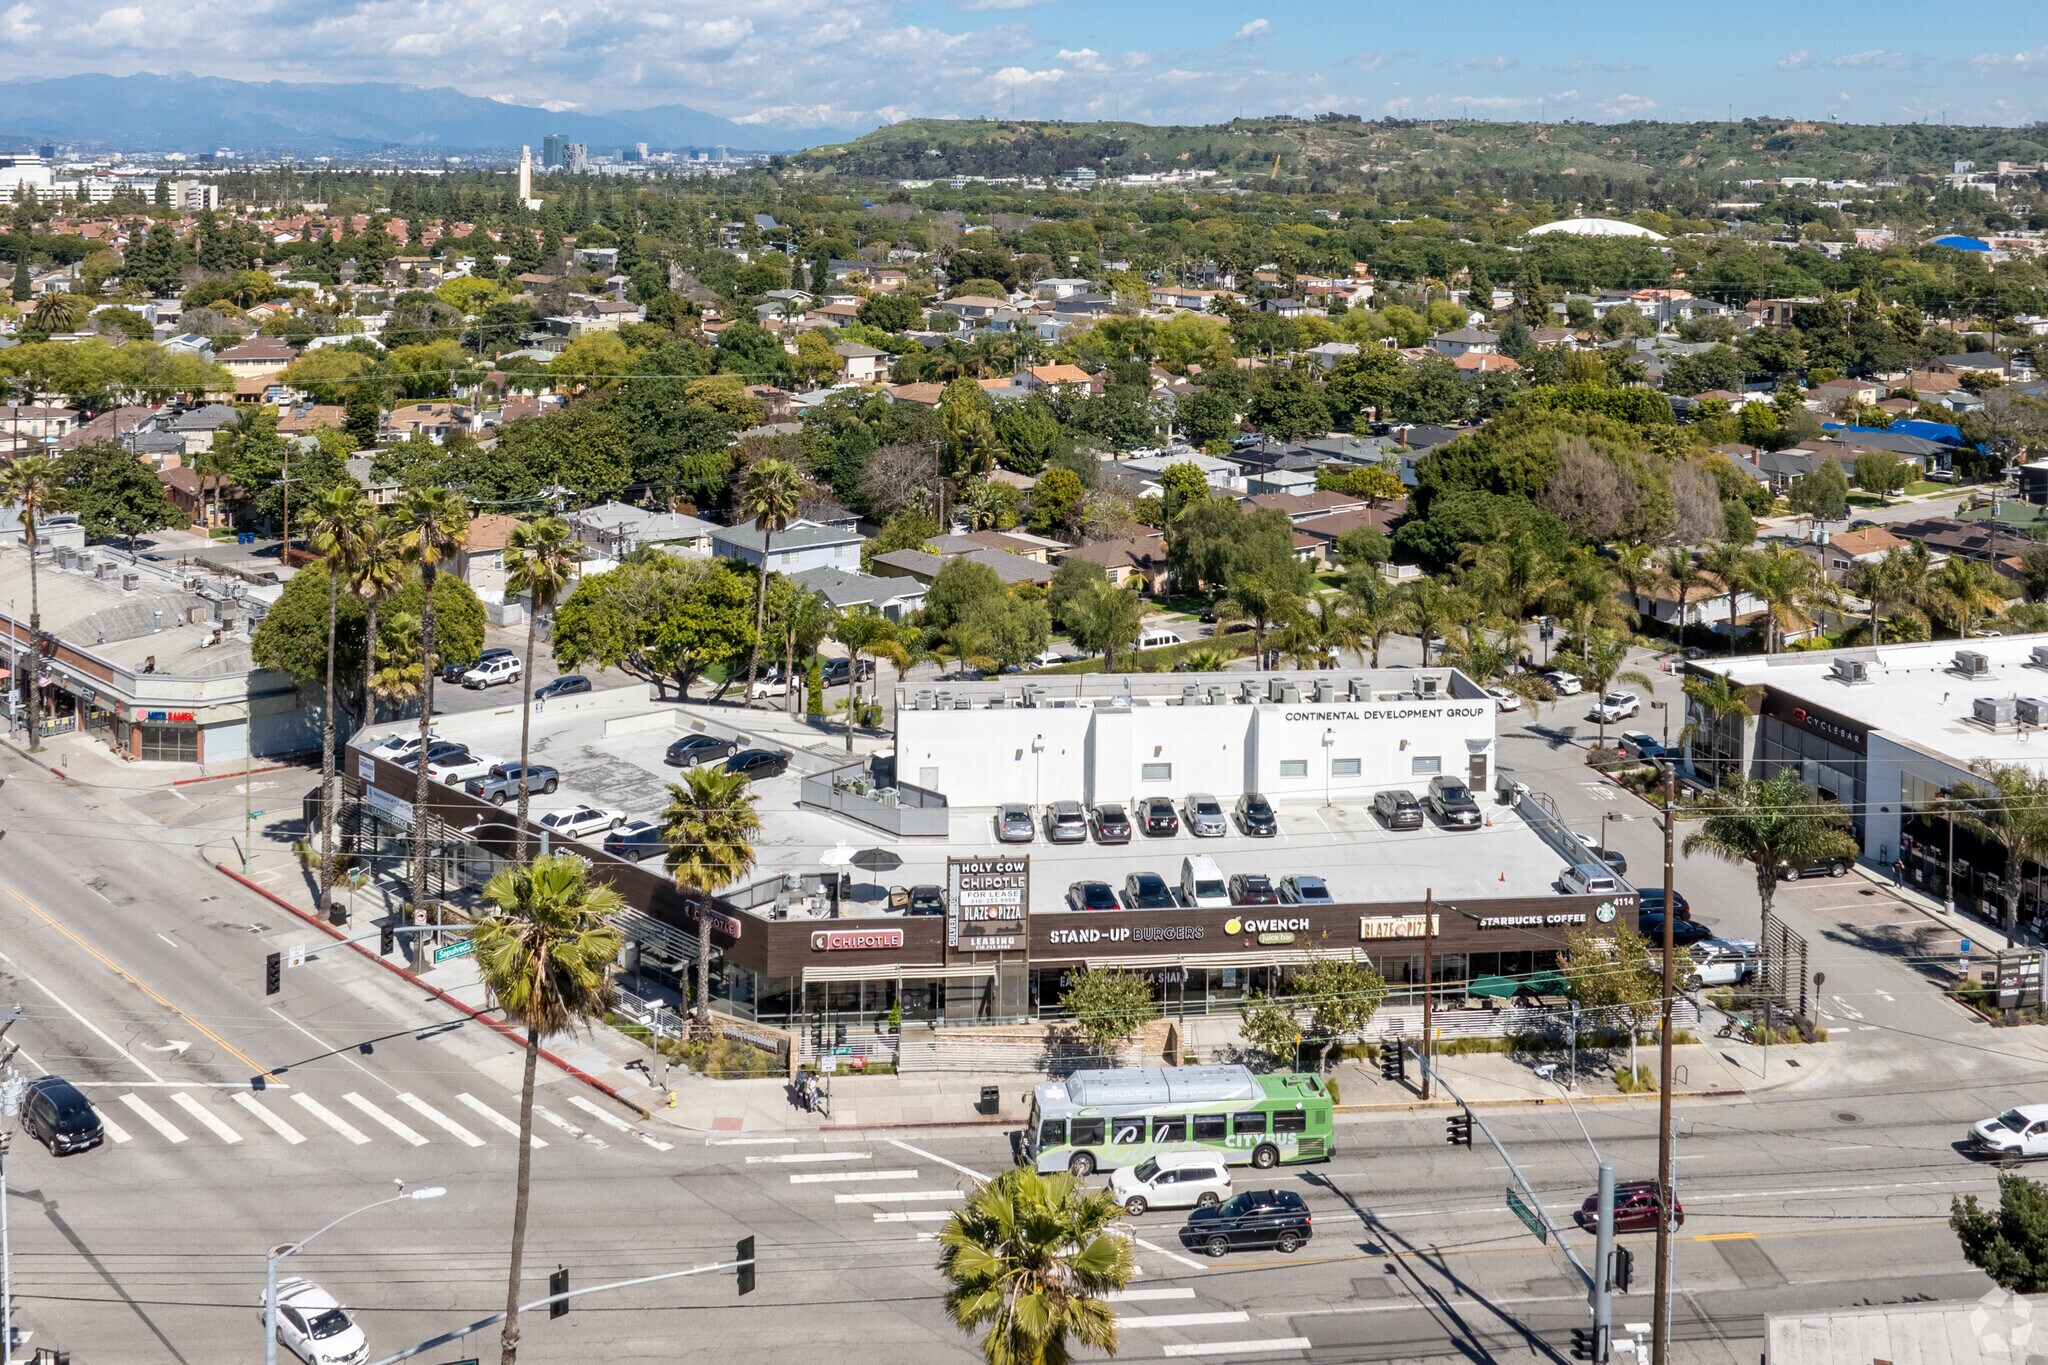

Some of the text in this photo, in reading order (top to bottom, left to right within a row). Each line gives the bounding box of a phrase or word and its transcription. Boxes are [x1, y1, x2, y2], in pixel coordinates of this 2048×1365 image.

[1285, 708, 1484, 721] CONTINENTAL DEVELOPMENT GROUP
[1806, 716, 1860, 744] CYCLEBAR
[371, 807, 391, 821] LEASING
[391, 815, 408, 828] OFFICE
[962, 862, 1025, 873] HOLY COW
[961, 876, 1026, 889] CHIPOTLE
[990, 890, 1019, 898] LEASE
[1613, 897, 1634, 906] 4114
[964, 905, 1021, 920] BLAZE PIZZA
[1244, 919, 1310, 932] QWENCH
[1480, 914, 1586, 926] STARBUCKS COFFEE
[948, 917, 956, 947] CULVER
[1050, 926, 1205, 943] STAND-UP BURGERS
[1262, 931, 1293, 942] juice bar
[1365, 922, 1394, 939] BLAZE
[832, 935, 899, 947] CHIPOTLE
[970, 937, 1015, 945] LEASING
